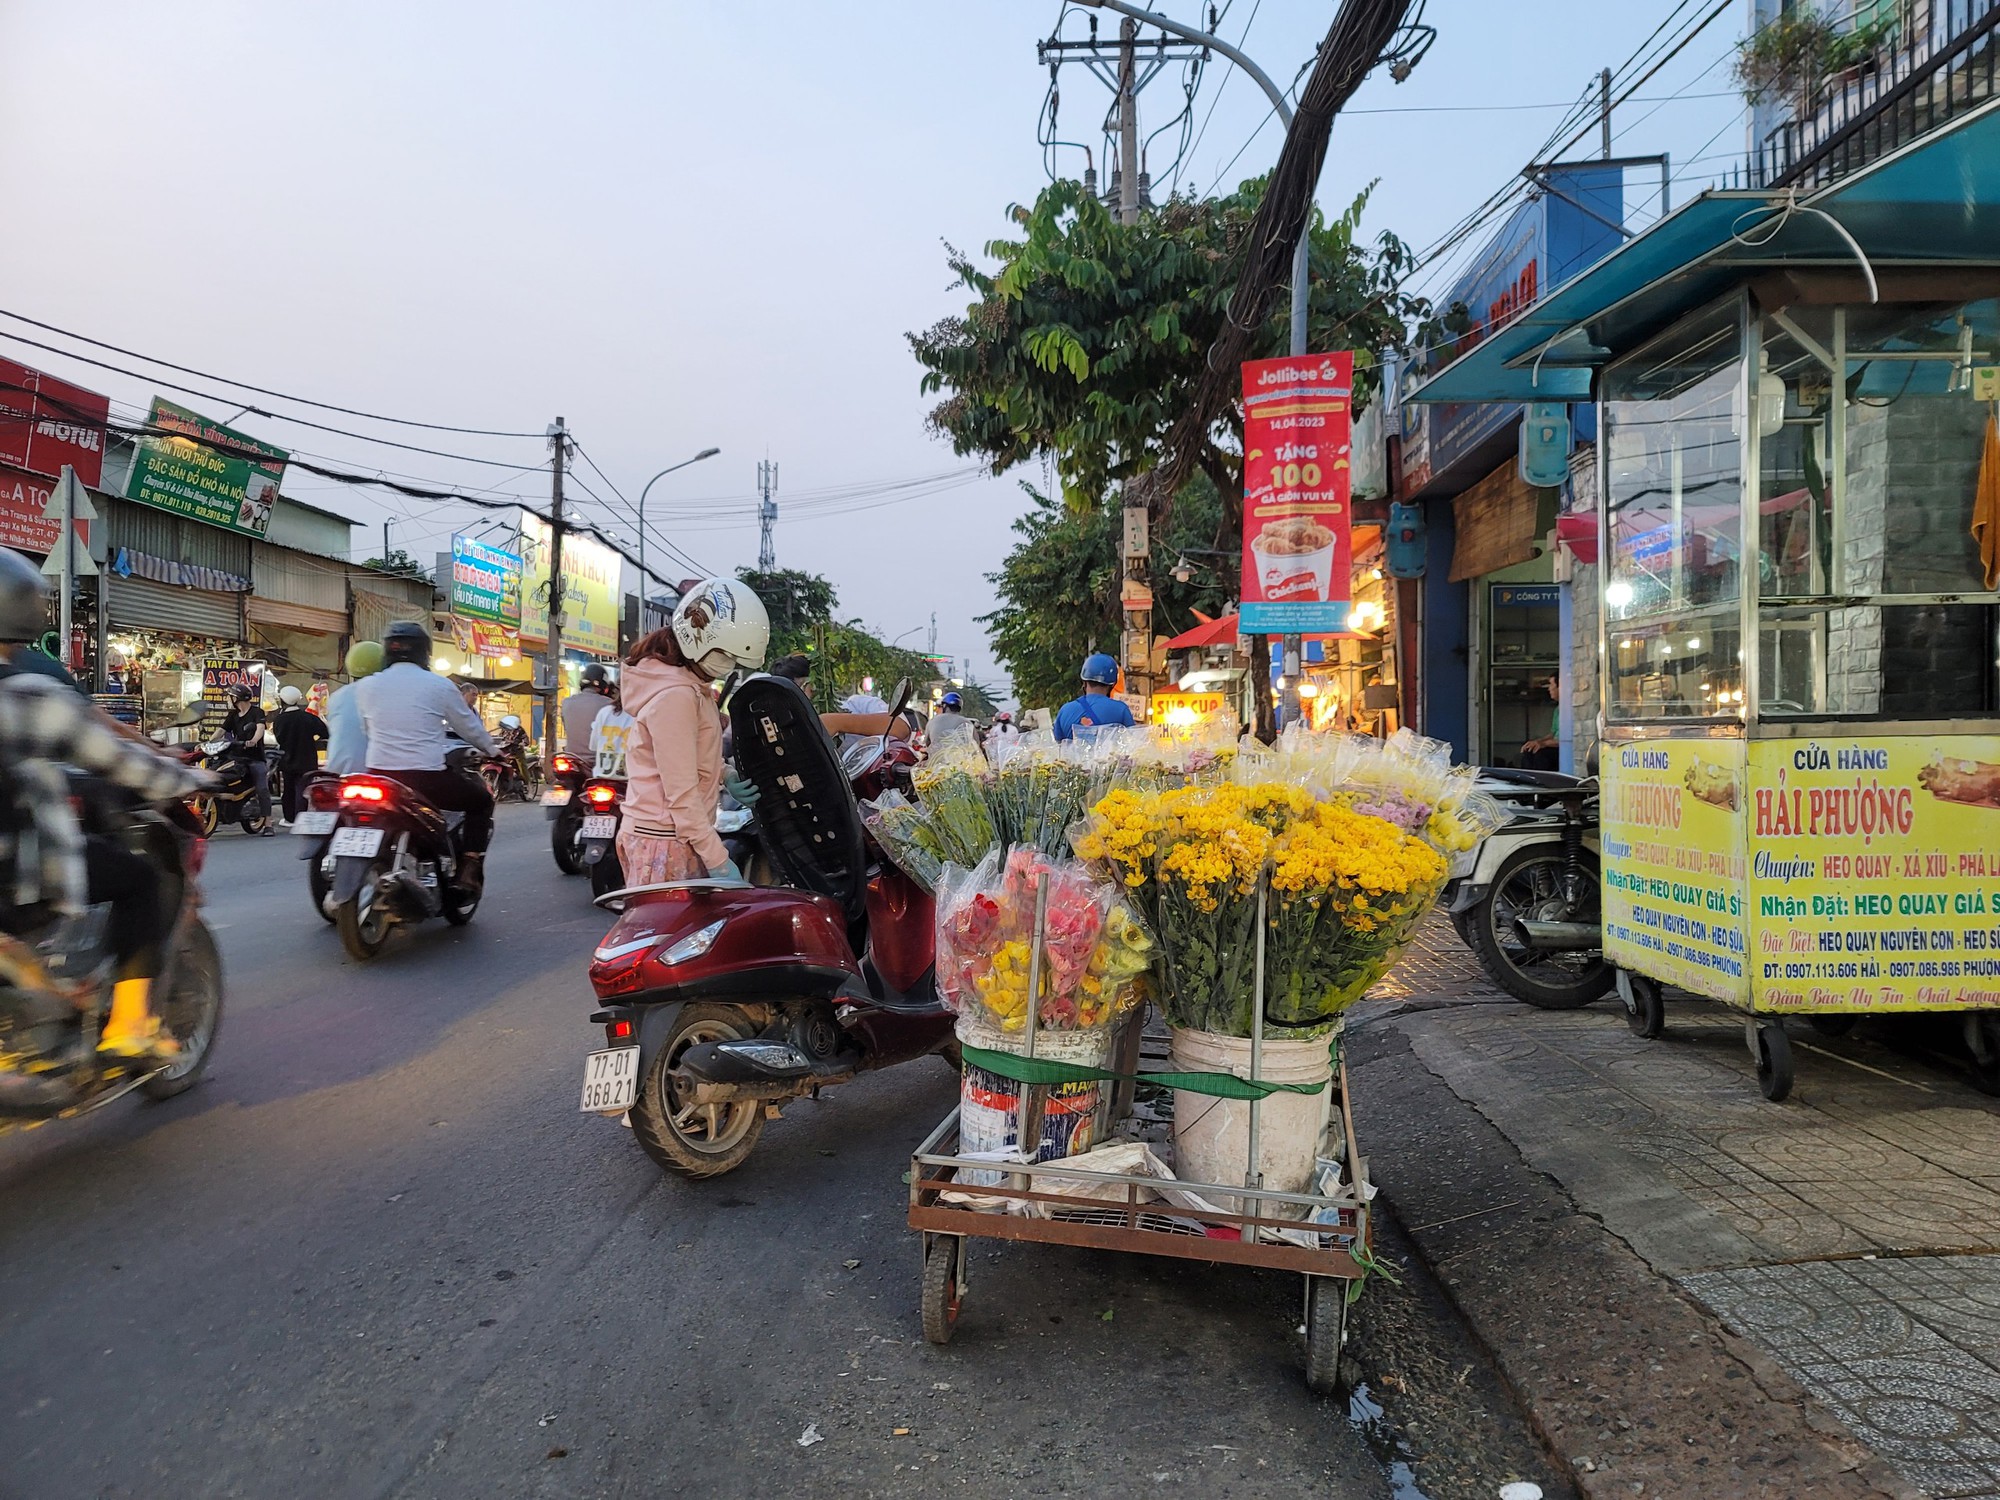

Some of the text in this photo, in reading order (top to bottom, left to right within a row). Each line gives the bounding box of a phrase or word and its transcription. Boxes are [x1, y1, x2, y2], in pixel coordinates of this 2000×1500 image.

[1258, 367, 1318, 385] Jollibee
[36, 420, 99, 453] MOTUL
[1270, 417, 1325, 430] 14.04.2023
[1275, 442, 1317, 461] TẶNG
[148, 457, 245, 502] ĐẶC SẢN ĐỒ KHÔ HÀ NỘI
[1270, 463, 1321, 488] 100
[1261, 492, 1276, 503] GÀ
[1302, 491, 1319, 501] VUI
[1516, 592, 1539, 600] CÔNG
[204, 670, 216, 686] A
[206, 660, 239, 669] TAY GA
[1621, 745, 1668, 770] CỬA HÀNG
[1793, 743, 1888, 770] CỬA HÀNG
[1628, 776, 1682, 836] PHƯỢNG
[1755, 768, 1914, 845] HẢI PHƯỢNG
[1635, 842, 1648, 861] HEO
[1650, 843, 1670, 866] QUAY
[1688, 845, 1702, 872] XÍU
[1708, 849, 1726, 877] PHÁ
[1753, 850, 1815, 884] Chuyên:
[1823, 855, 1851, 878] HEO
[1855, 855, 1892, 879] QUAY
[1904, 848, 1921, 877] XÁ
[1926, 848, 1948, 877] XÍU
[1959, 848, 1985, 877] PHÁ
[1606, 869, 1628, 892] Nhận
[1649, 878, 1670, 900] HEO
[1672, 883, 1703, 906] QUAY
[1705, 888, 1727, 913] GIÁ
[1761, 895, 1807, 922] Nhận
[1812, 895, 1849, 922] Đặt:
[1855, 894, 1893, 915] HEO
[1898, 894, 1948, 915] QUAY
[1954, 888, 1986, 914] GIÁ
[1632, 905, 1644, 924] HEO
[1645, 908, 1662, 929] QUAY
[1662, 914, 1690, 937] NGUYÊN
[1691, 920, 1706, 941] CON
[1711, 925, 1727, 948] HEO
[1617, 926, 1652, 948] 0907.113.606
[1667, 941, 1711, 967] 0907.086.986
[1711, 953, 1742, 979] PHƯỢNG
[1760, 928, 1784, 958] Đặc
[1788, 928, 1815, 958] Biệt:
[1819, 932, 1842, 951] HEO
[1846, 931, 1877, 952] QUAY
[1880, 927, 1927, 951] NGUYÊN
[1931, 931, 1954, 950] CON
[1964, 930, 1987, 950] HEO
[1764, 963, 1782, 978] ĐT:
[1785, 963, 1858, 978] 0907.113.606
[1860, 956, 1880, 978] HẢI
[1889, 962, 1960, 978] 0907.086.986
[1764, 987, 1803, 1006] Đảm
[1807, 986, 1844, 1006] Bảo:
[1849, 987, 1872, 1007] Uy
[1880, 986, 1904, 1004] Tín
[1917, 986, 1951, 1004] Chất
[584, 1078, 632, 1108] 368.21
